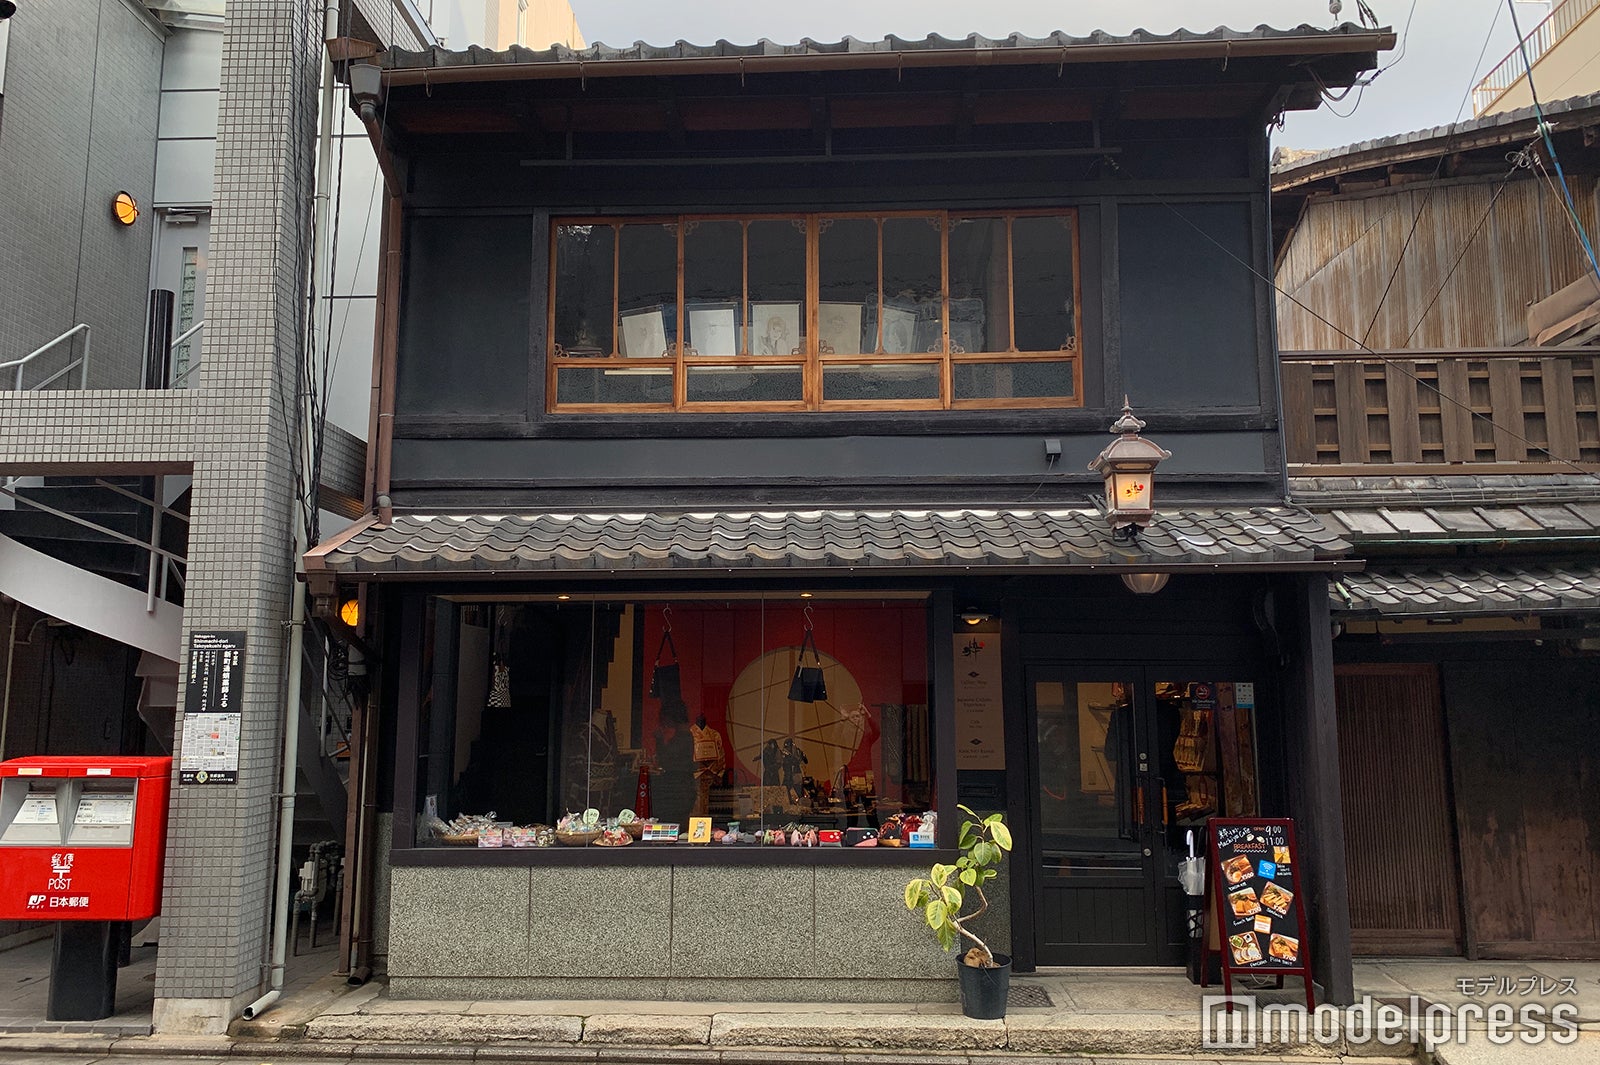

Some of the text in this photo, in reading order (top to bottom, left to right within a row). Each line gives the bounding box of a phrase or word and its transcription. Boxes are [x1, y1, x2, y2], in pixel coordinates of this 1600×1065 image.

[51, 853, 75, 867] 郵便
[47, 878, 72, 890] POST
[49, 896, 89, 908] 日本郵便
